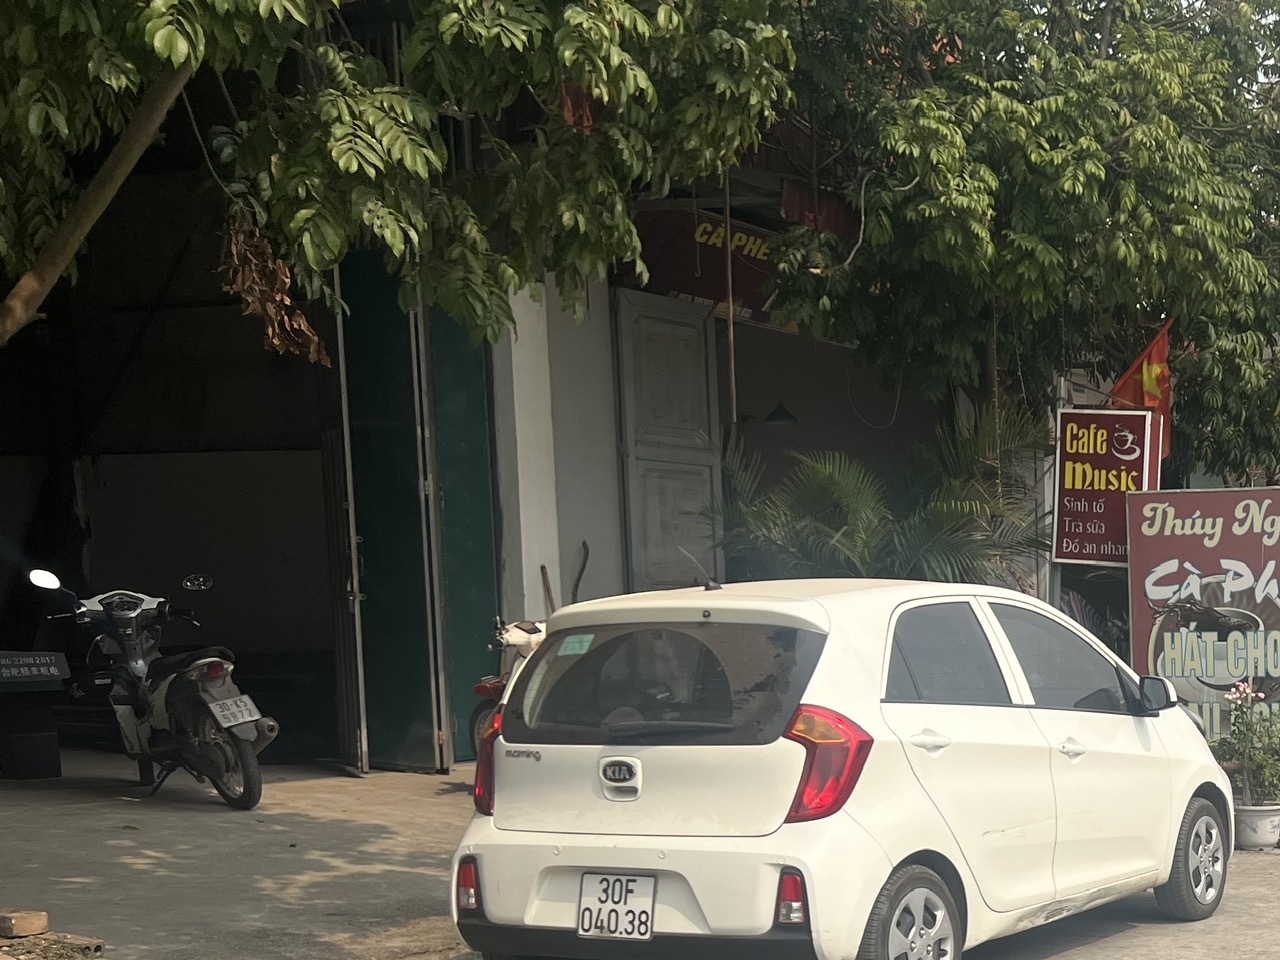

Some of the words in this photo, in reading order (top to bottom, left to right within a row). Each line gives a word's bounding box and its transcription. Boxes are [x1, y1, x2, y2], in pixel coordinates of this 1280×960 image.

[1065, 421, 1107, 455] Cafe
[1064, 460, 1139, 492] Music
[1063, 496, 1089, 512] Sinh
[1140, 501, 1224, 548] Thúy
[1100, 541, 1128, 555] nhan
[1145, 558, 1202, 601] Cà
[1162, 621, 1224, 678] HÁT
[606, 766, 630, 779] KIA
[598, 877, 638, 905] 30F
[580, 907, 649, 936] 040.38
